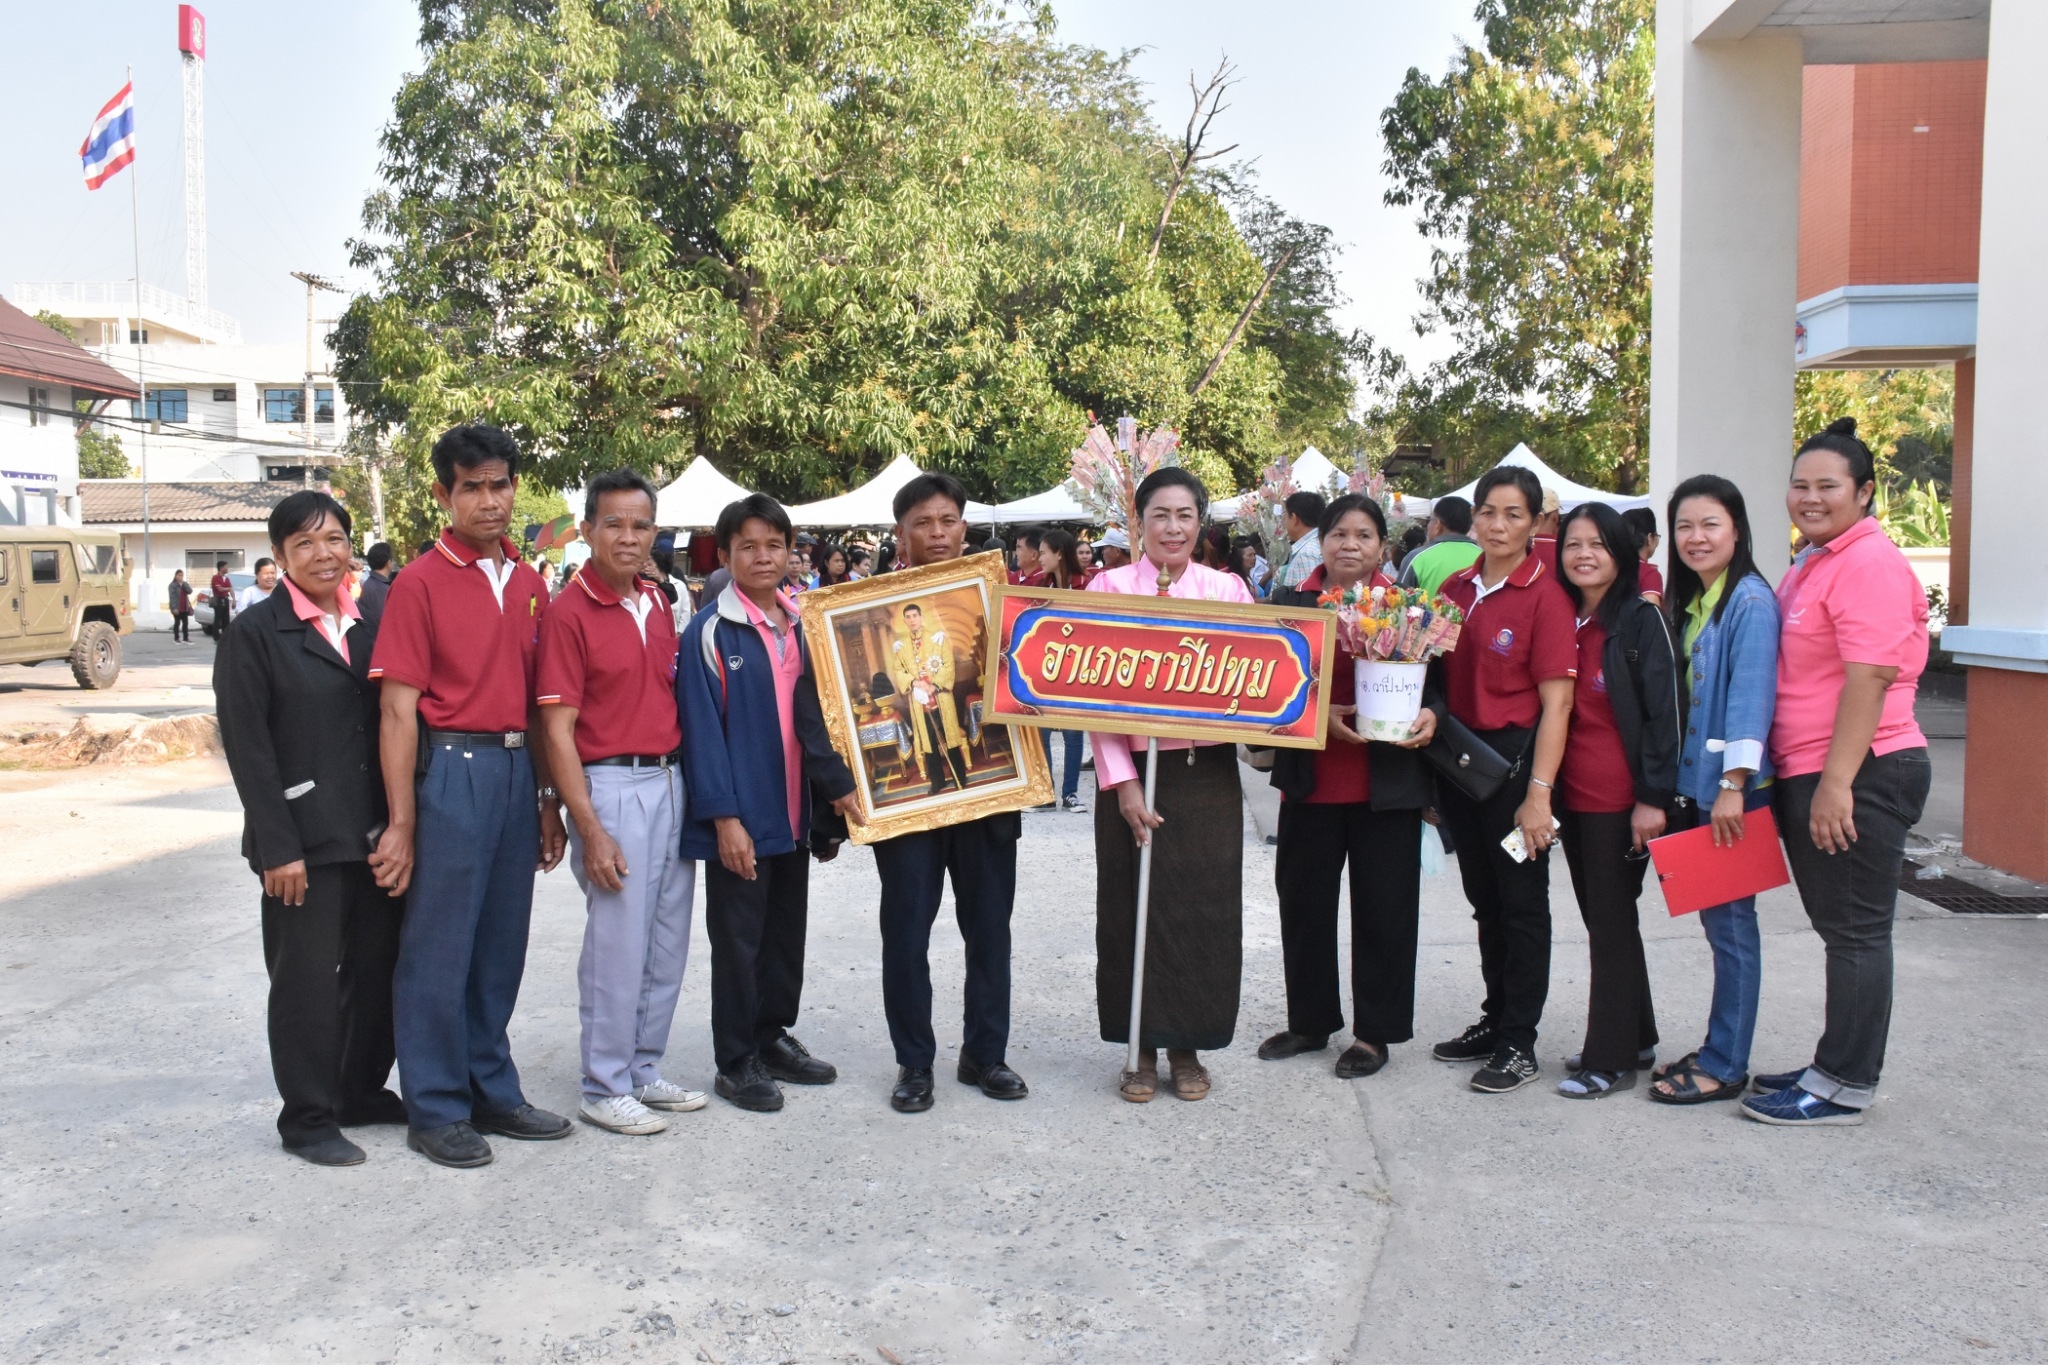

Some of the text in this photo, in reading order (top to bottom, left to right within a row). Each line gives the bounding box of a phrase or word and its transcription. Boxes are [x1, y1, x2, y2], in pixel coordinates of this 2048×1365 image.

[1041, 622, 1278, 716] อำเภอวาปีปทุม
